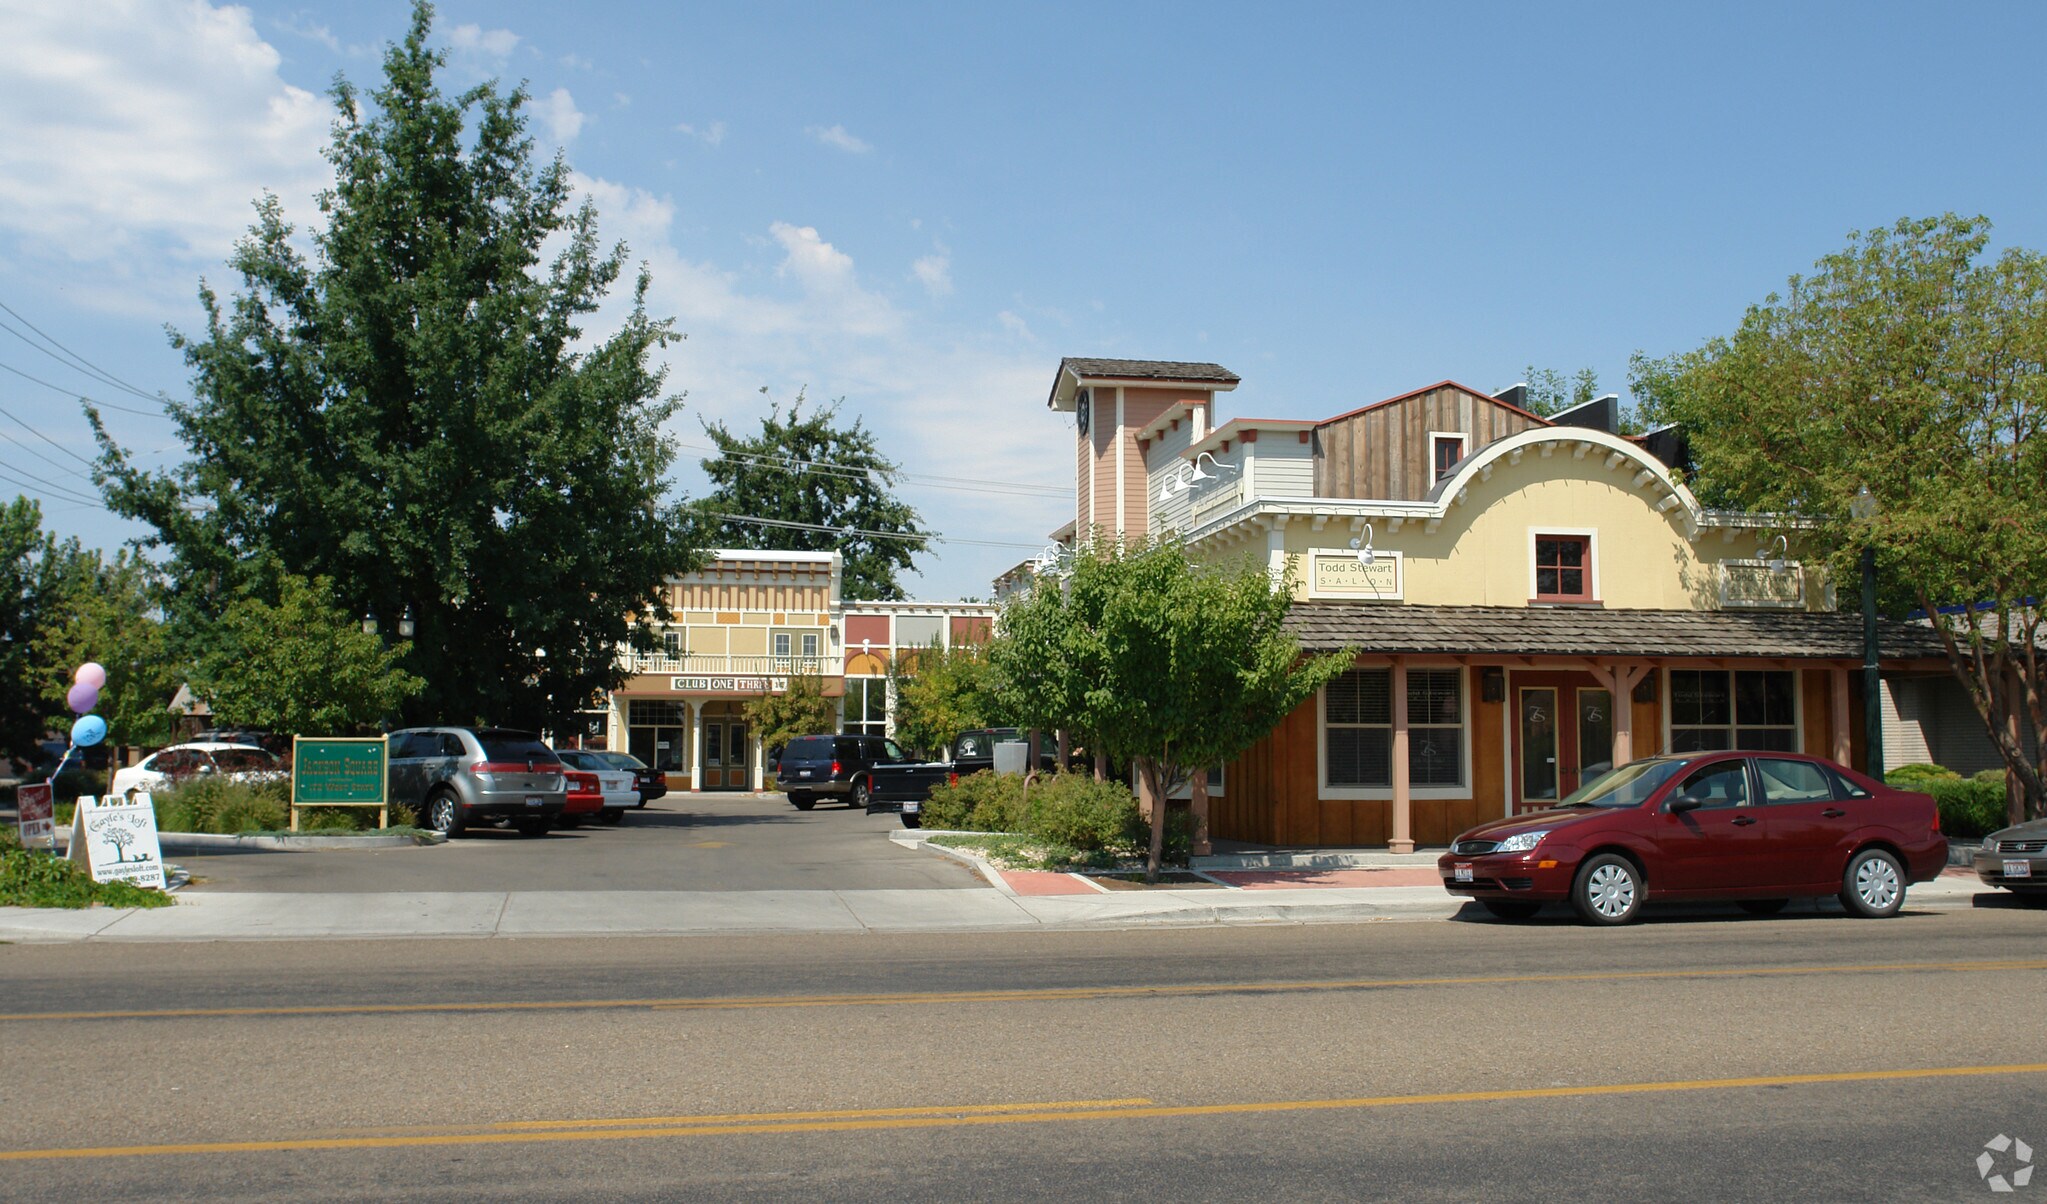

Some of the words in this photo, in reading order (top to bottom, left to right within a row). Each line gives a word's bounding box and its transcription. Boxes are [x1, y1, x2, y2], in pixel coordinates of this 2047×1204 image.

[1318, 563, 1345, 572] Todd
[1350, 563, 1392, 573] Stewart
[677, 680, 707, 690] CLUB
[712, 680, 734, 689] ONE
[89, 813, 124, 832] Gayle's
[127, 814, 148, 828] Loft
[96, 864, 159, 876] www.gaylesloft.com
